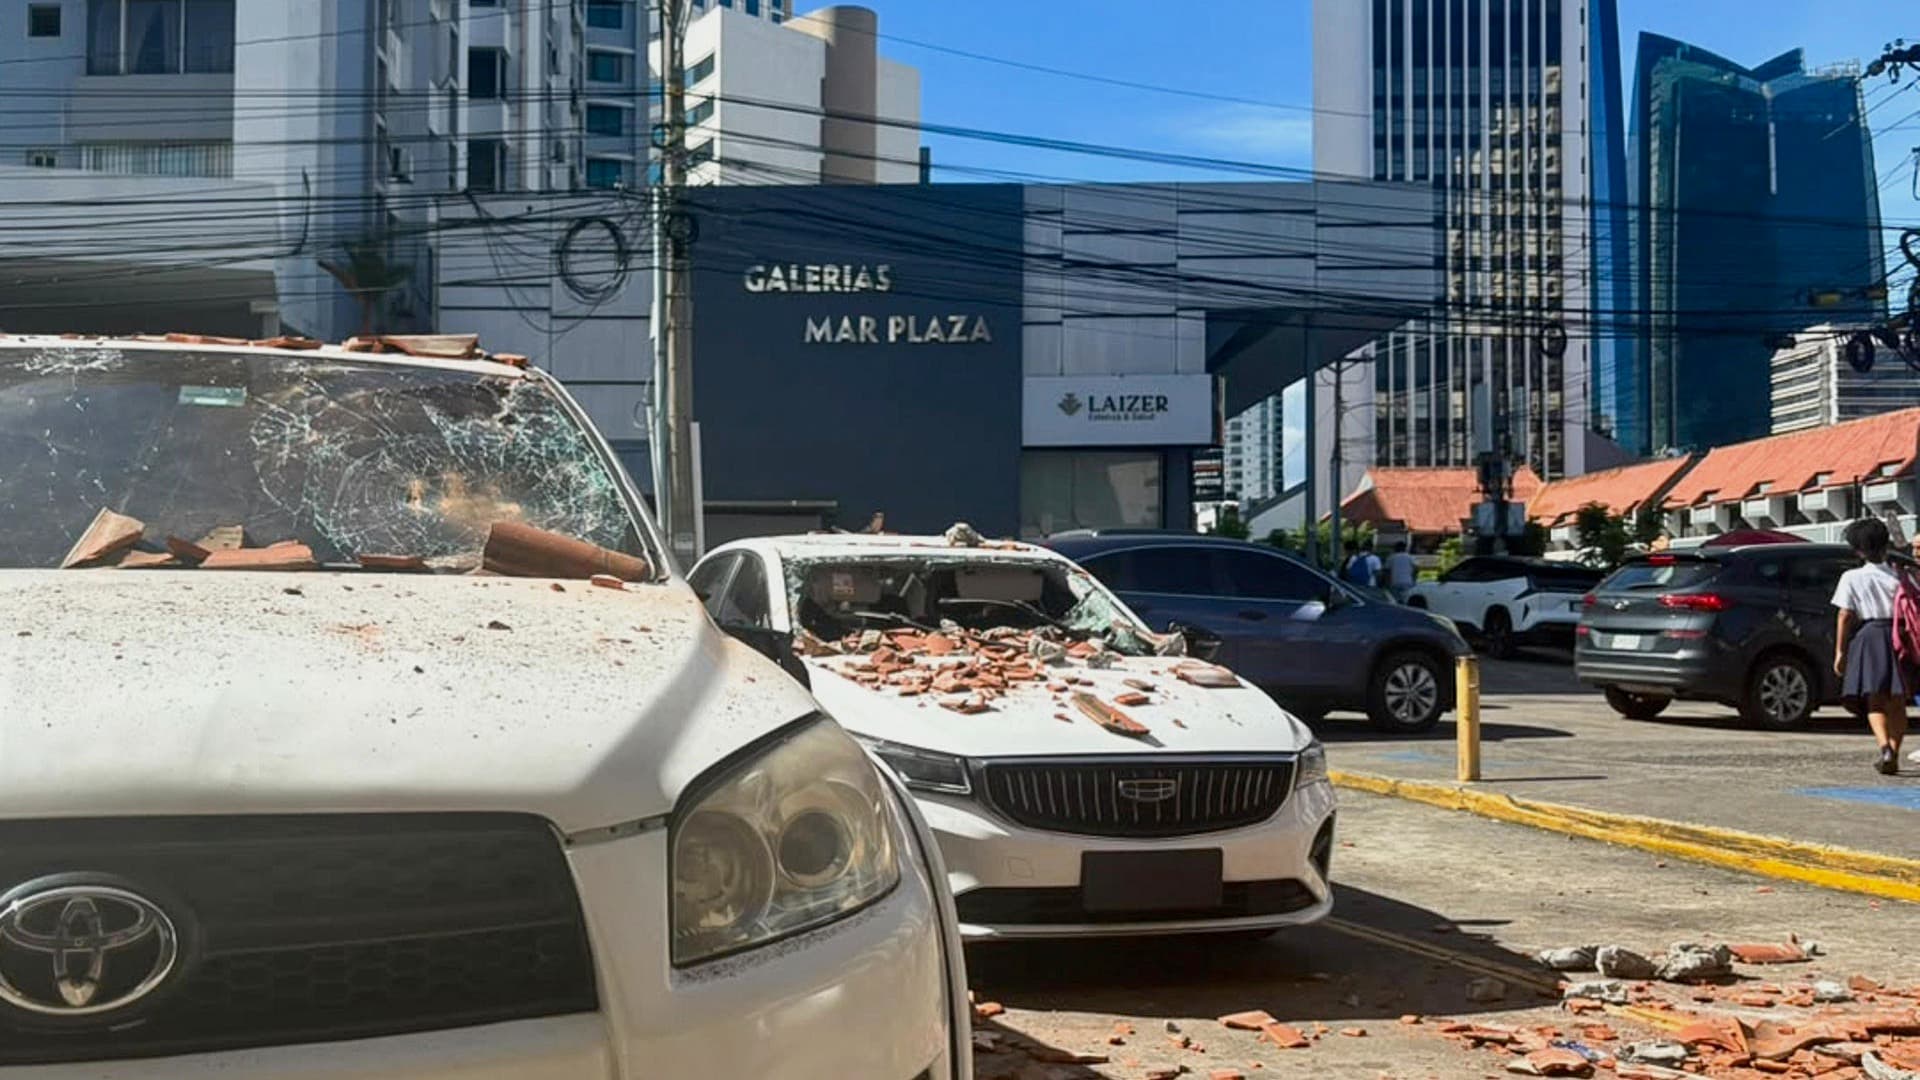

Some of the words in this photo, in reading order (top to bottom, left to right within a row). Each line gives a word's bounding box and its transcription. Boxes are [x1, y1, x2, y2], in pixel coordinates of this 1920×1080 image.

[745, 263, 891, 292] GALERIAS
[804, 315, 878, 343] MAR
[887, 315, 992, 343] PLAZA
[1088, 395, 1169, 412] LAIZER
